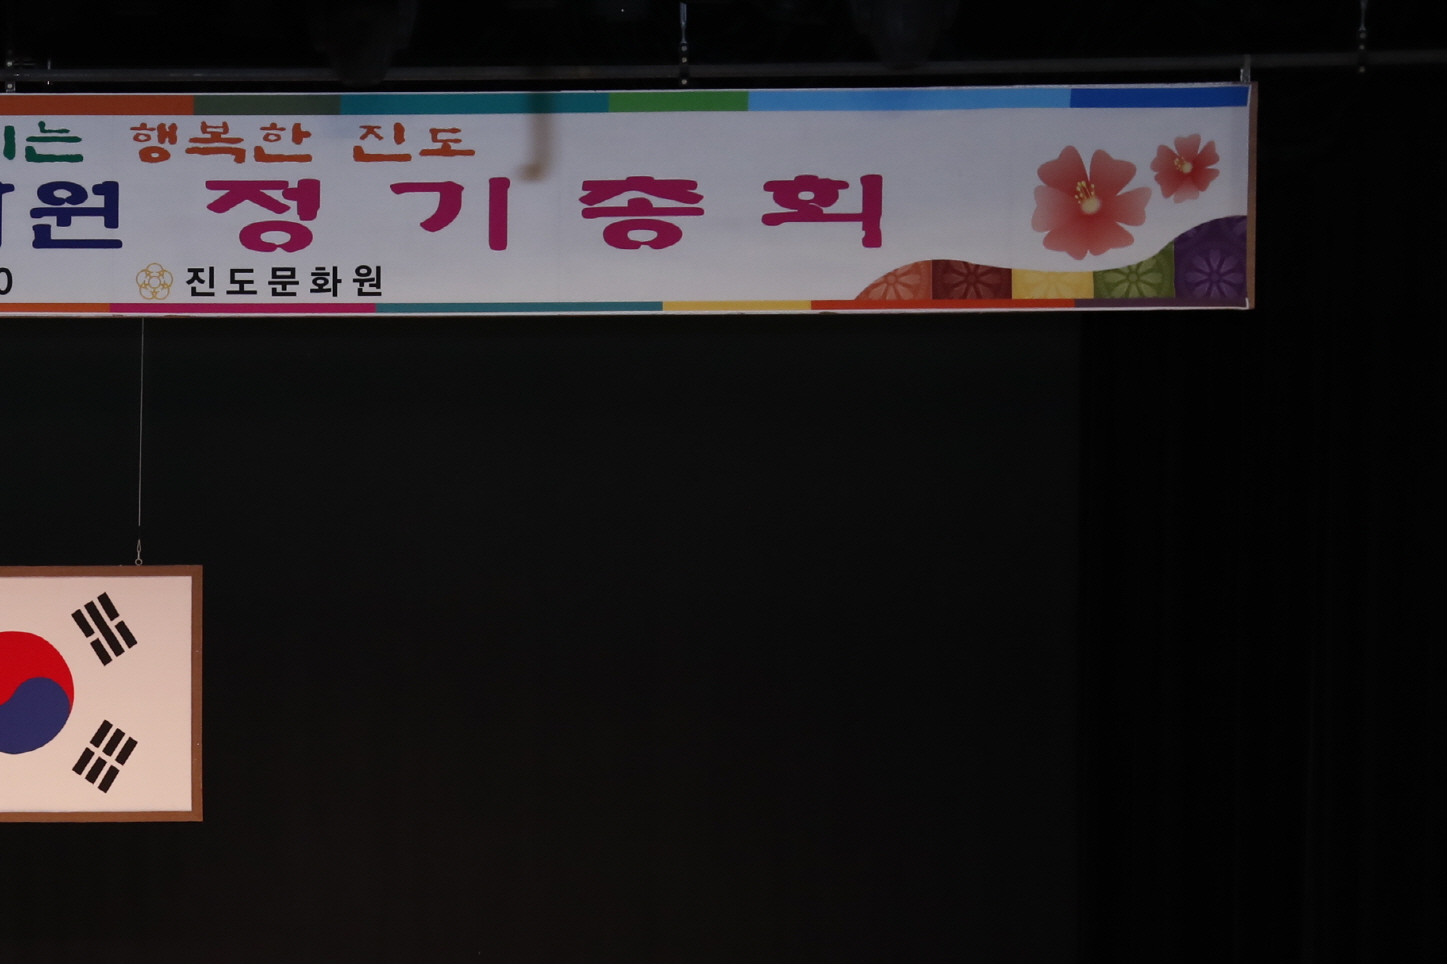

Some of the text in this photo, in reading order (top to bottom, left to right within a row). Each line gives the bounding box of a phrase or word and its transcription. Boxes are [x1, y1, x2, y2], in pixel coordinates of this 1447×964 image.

[130, 121, 313, 164] 행복한
[352, 121, 476, 163] 진도
[186, 265, 382, 298] 진도문화원
